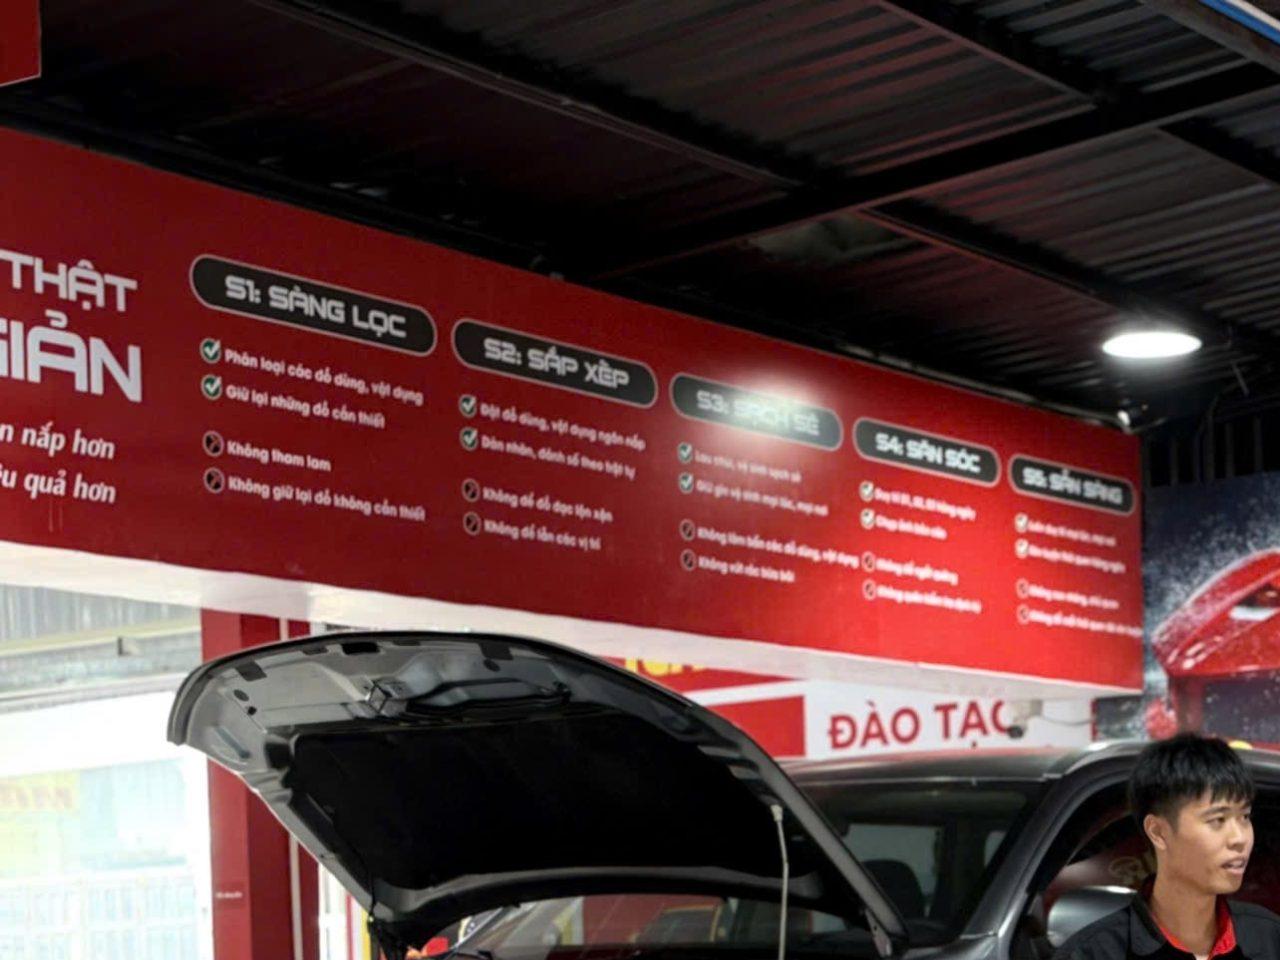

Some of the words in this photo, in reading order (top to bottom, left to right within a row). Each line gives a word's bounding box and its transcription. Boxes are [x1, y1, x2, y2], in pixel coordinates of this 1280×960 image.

[0, 248, 137, 312] THẬT
[225, 274, 261, 304] S1:
[268, 284, 345, 324] SÀNG
[352, 305, 408, 338] LỌC
[0, 309, 142, 402] IẢN
[261, 356, 285, 376] loại
[287, 362, 313, 379] các
[21, 421, 66, 457] nắp
[72, 428, 116, 460] hơn
[227, 440, 269, 464] Không
[272, 448, 305, 467] tham
[307, 456, 331, 472] lam
[24, 469, 66, 500] quả
[73, 473, 117, 504] hơn
[228, 476, 271, 500] Không
[827, 701, 921, 750] ĐÀO
